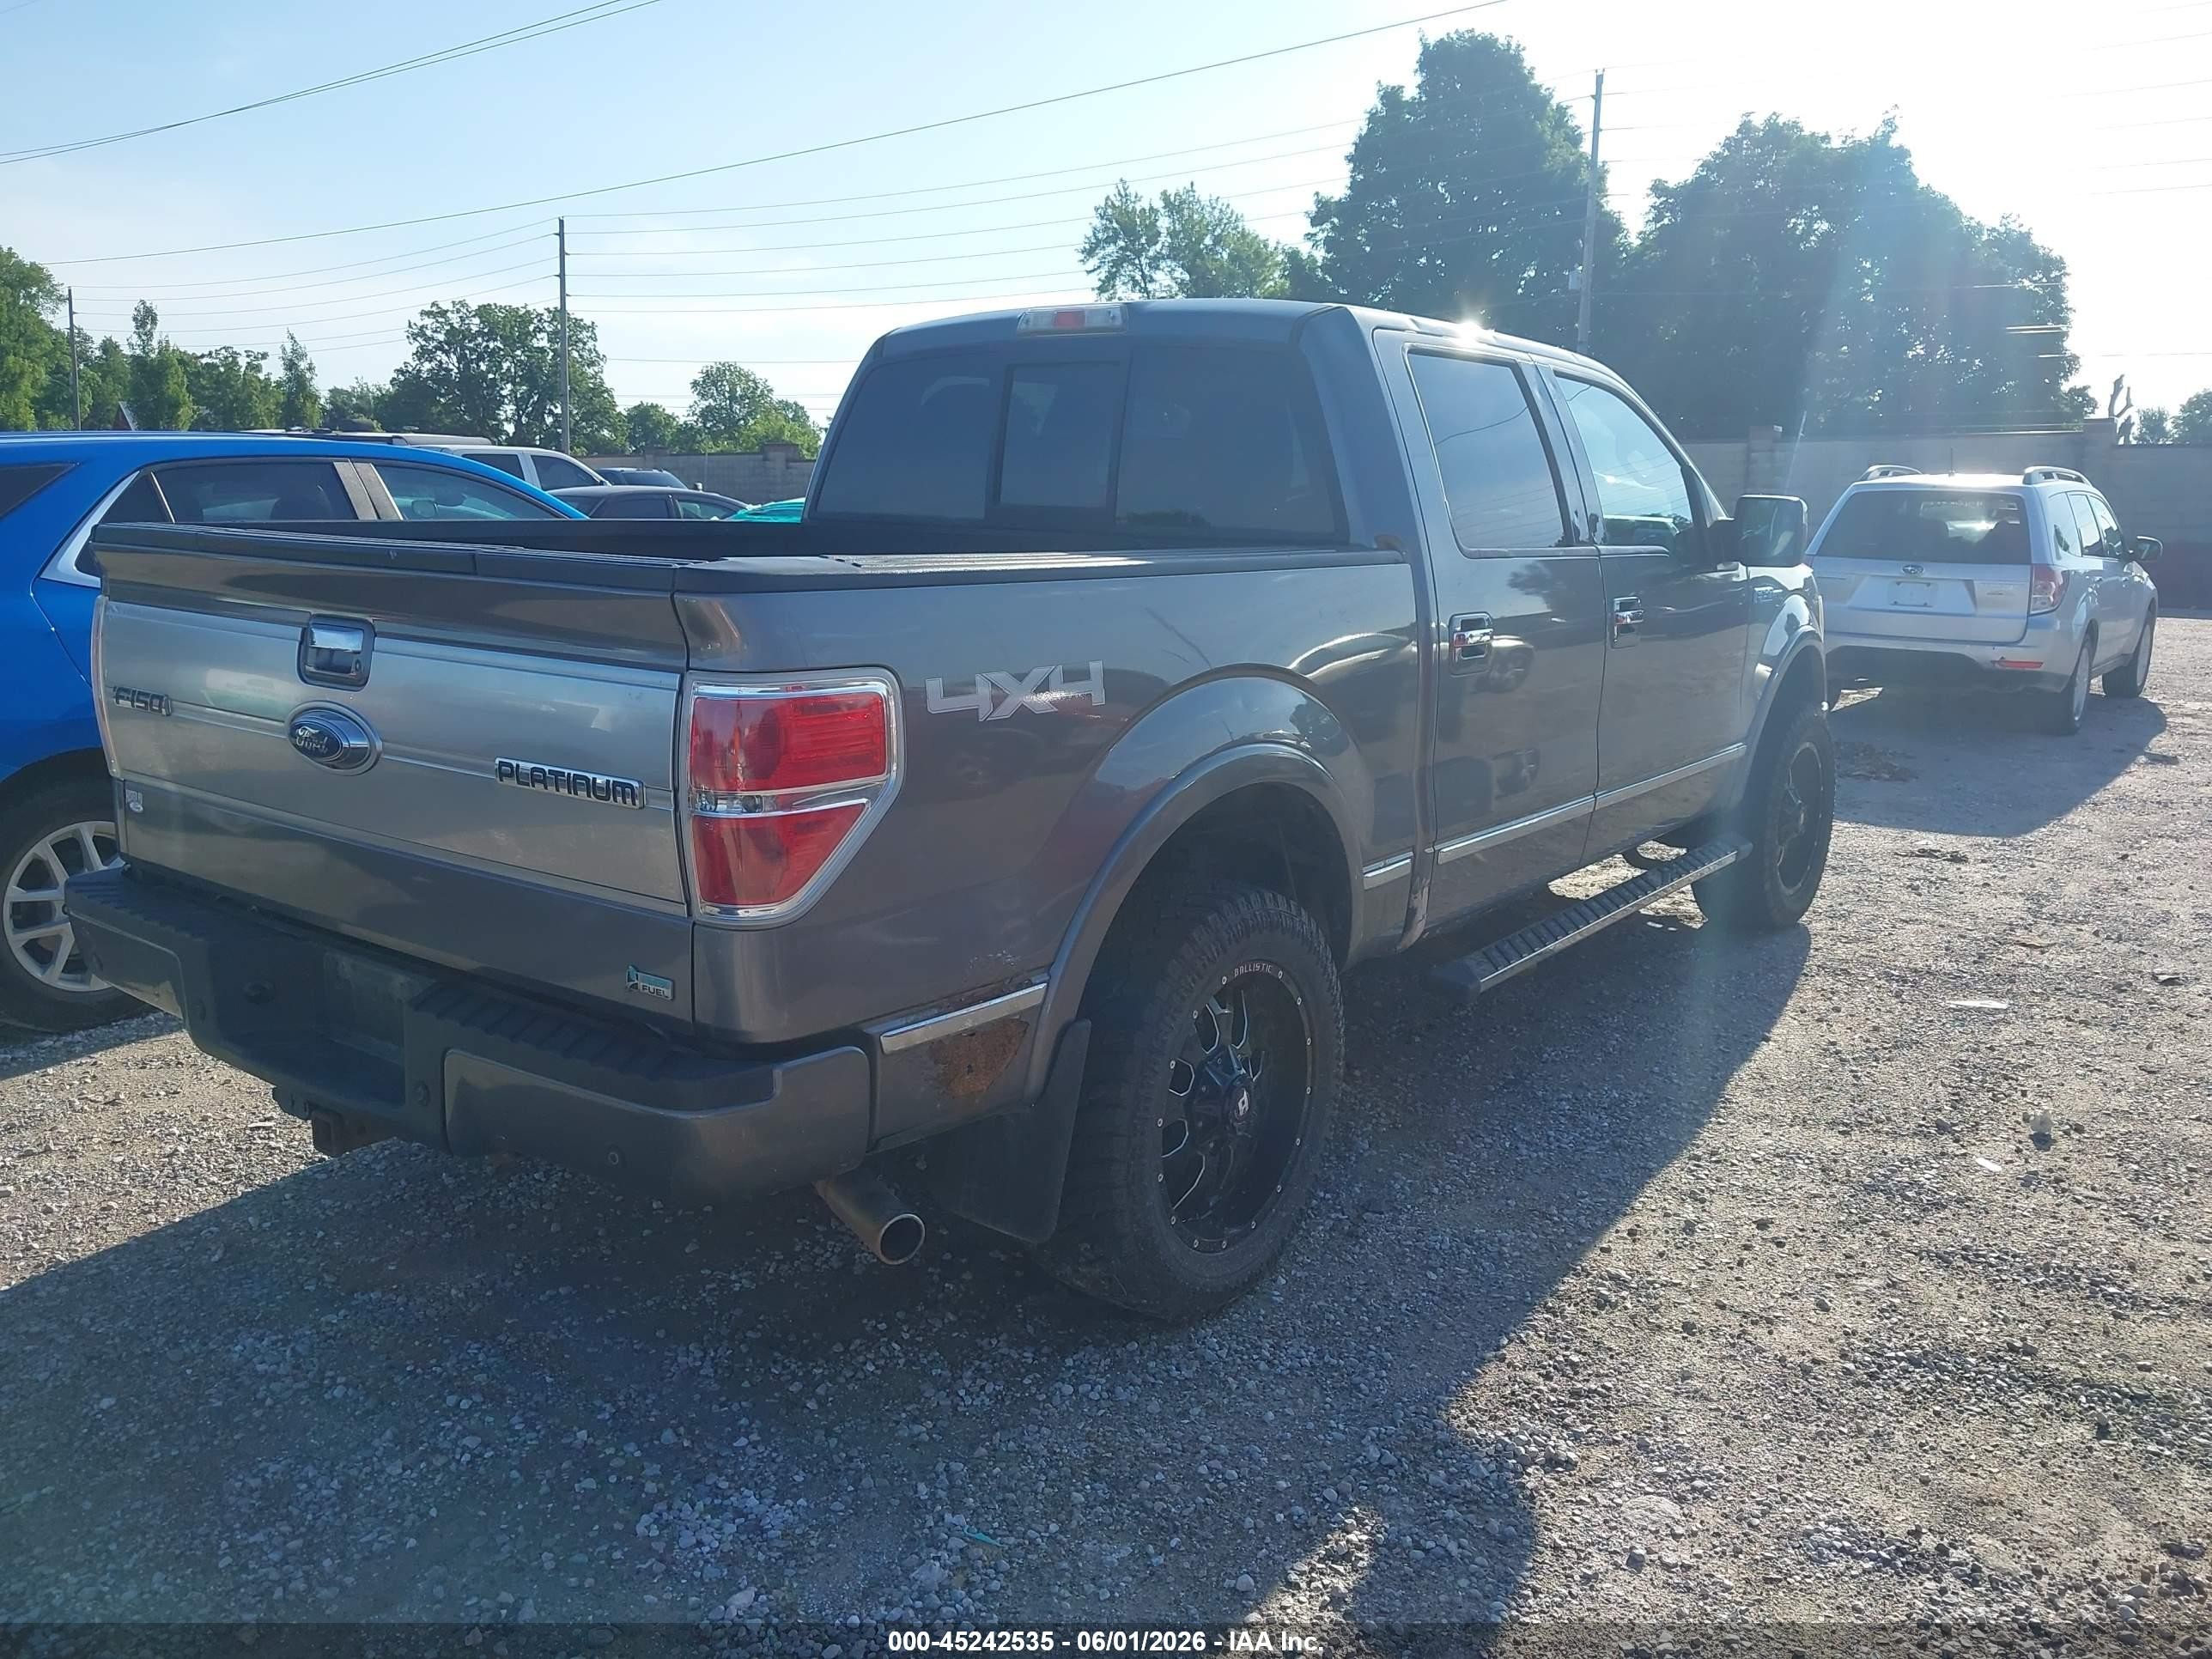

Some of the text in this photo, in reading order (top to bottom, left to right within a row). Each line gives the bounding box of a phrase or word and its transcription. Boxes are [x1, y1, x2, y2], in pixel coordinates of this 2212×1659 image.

[295, 726, 328, 754] Ford
[498, 760, 636, 806] PLATINUM
[1234, 962, 1272, 978] BALLISTIC
[641, 984, 670, 999] FUEL
